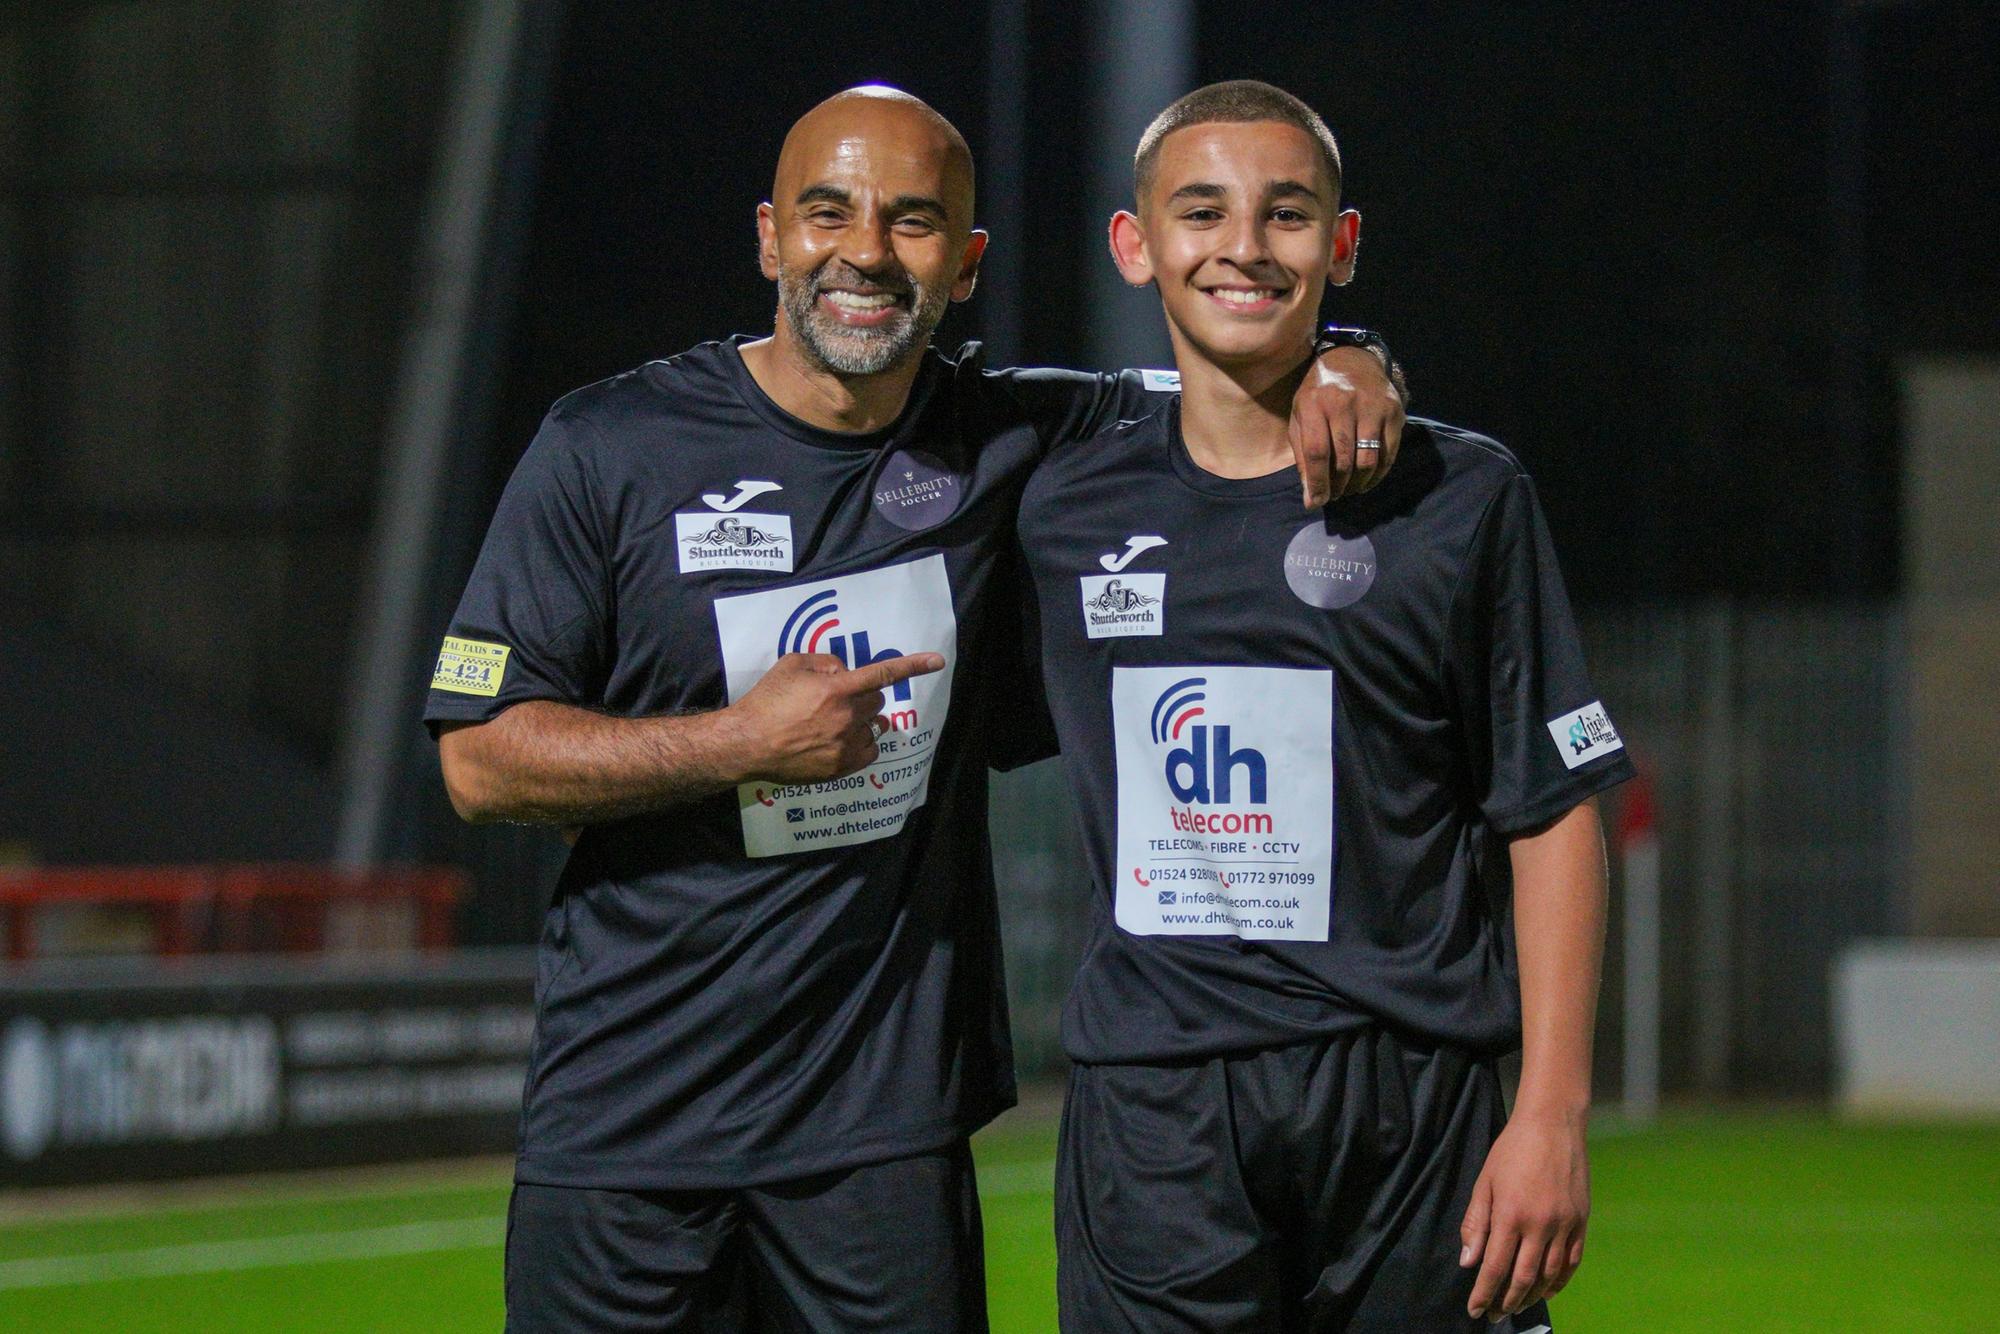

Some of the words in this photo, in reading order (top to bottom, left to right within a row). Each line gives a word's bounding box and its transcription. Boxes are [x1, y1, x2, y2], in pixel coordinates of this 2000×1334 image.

[875, 475, 952, 505] SELLEBRITY
[900, 491, 942, 507] SOCCER
[688, 545, 784, 559] Shuttleworth
[1287, 552, 1373, 576] SELLEBRITY
[1307, 568, 1352, 582] SOCCER
[1089, 609, 1155, 625] Shuttleworth
[444, 640, 461, 652] TAL
[463, 643, 488, 655] TAXIS
[910, 729, 934, 747] CCTV
[1165, 725, 1267, 804] dh
[772, 784, 812, 800] 01524
[815, 775, 865, 794] 928009
[882, 765, 913, 784] 01772
[1171, 806, 1273, 834] telecom
[1211, 842, 1247, 854] FIBRE
[1262, 842, 1300, 854] CCTV
[1149, 869, 1186, 880] 01524
[1228, 872, 1265, 884] 01772
[1268, 872, 1315, 885] 971099
